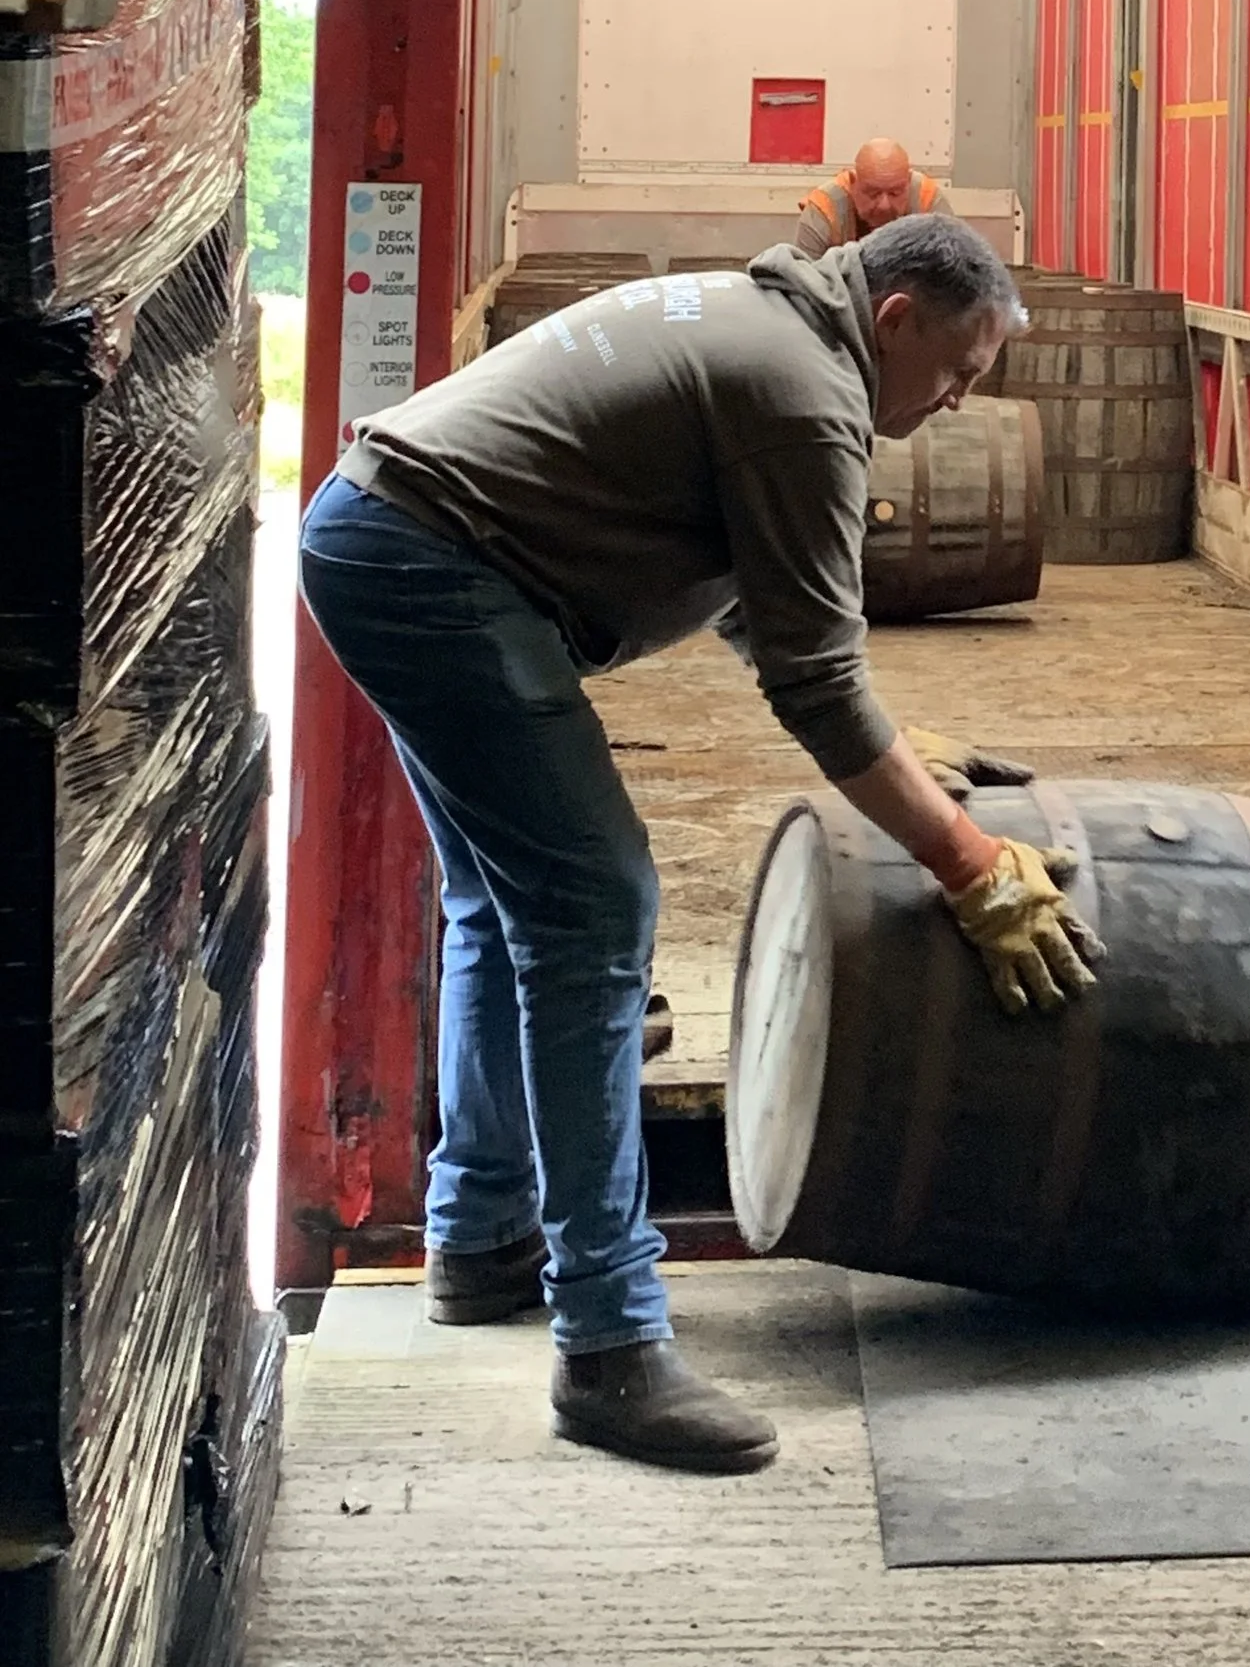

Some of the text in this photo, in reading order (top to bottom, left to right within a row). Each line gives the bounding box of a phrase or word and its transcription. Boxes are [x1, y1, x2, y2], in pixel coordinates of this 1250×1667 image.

[379, 190, 416, 202] DECK
[388, 204, 406, 215] UP
[378, 230, 414, 241] DECK
[376, 243, 416, 255] DOWN
[385, 271, 405, 282] LOW
[372, 284, 417, 296] PRESSURE
[378, 321, 409, 333] SPOT
[372, 335, 414, 347] LIGHTS
[370, 361, 413, 373] INTERIOR
[374, 375, 408, 387] LIGHTS
